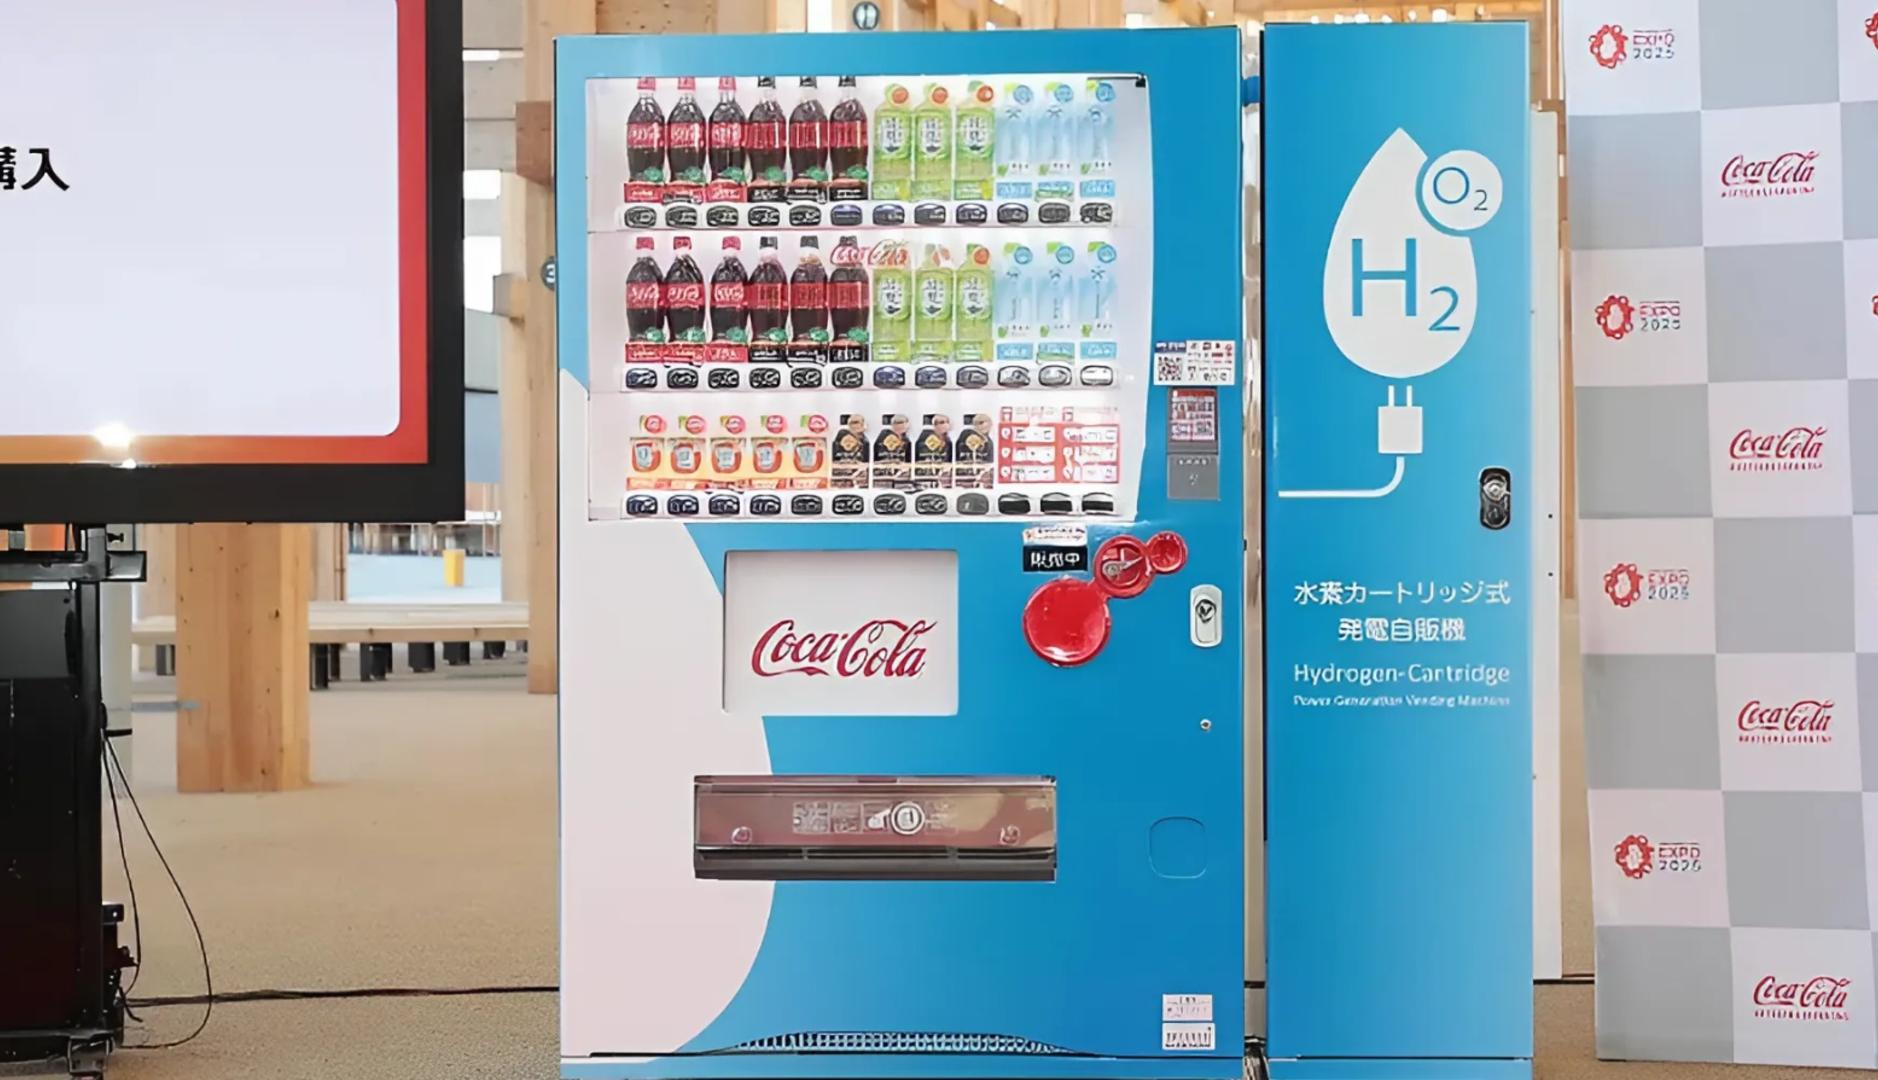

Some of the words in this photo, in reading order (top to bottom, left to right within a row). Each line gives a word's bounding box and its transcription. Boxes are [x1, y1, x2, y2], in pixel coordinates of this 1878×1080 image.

[1433, 167, 1488, 211] O2
[1352, 238, 1460, 331] H2
[1294, 580, 1511, 605] 水素カートリッジ式
[1338, 617, 1466, 642] 発電自販機
[751, 619, 938, 678] Coca-Cola
[1294, 663, 1510, 686] Hydrogen-Cartridge
